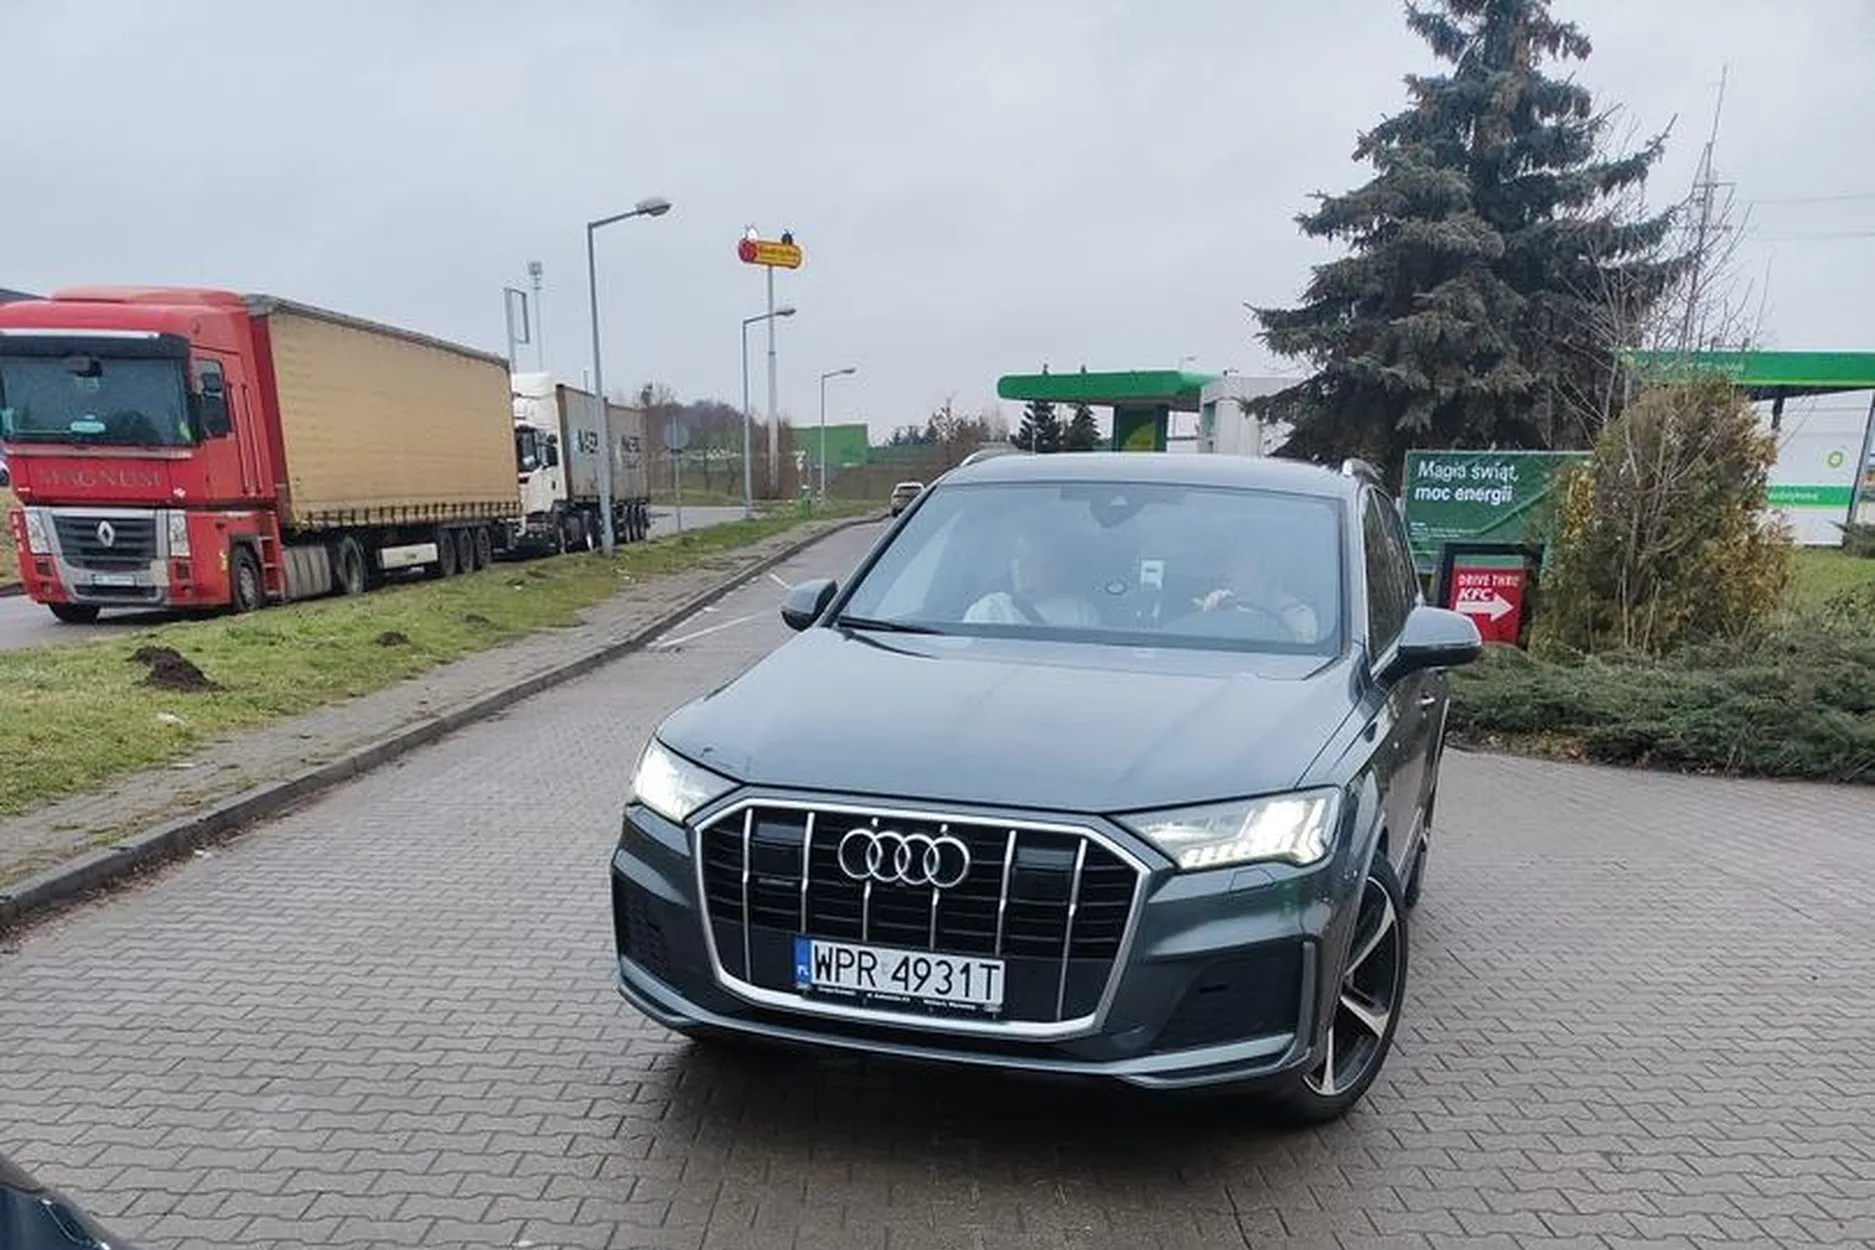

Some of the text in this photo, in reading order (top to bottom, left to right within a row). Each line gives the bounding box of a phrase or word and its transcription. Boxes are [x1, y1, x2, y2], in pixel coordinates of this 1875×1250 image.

[38, 468, 161, 487] MAGNUM
[1418, 461, 1466, 481] Magia
[1415, 485, 1513, 506] moc energii
[1458, 574, 1491, 587] DRIVE
[1459, 587, 1492, 600] KFC
[814, 945, 1000, 1001] WPR 4931T
